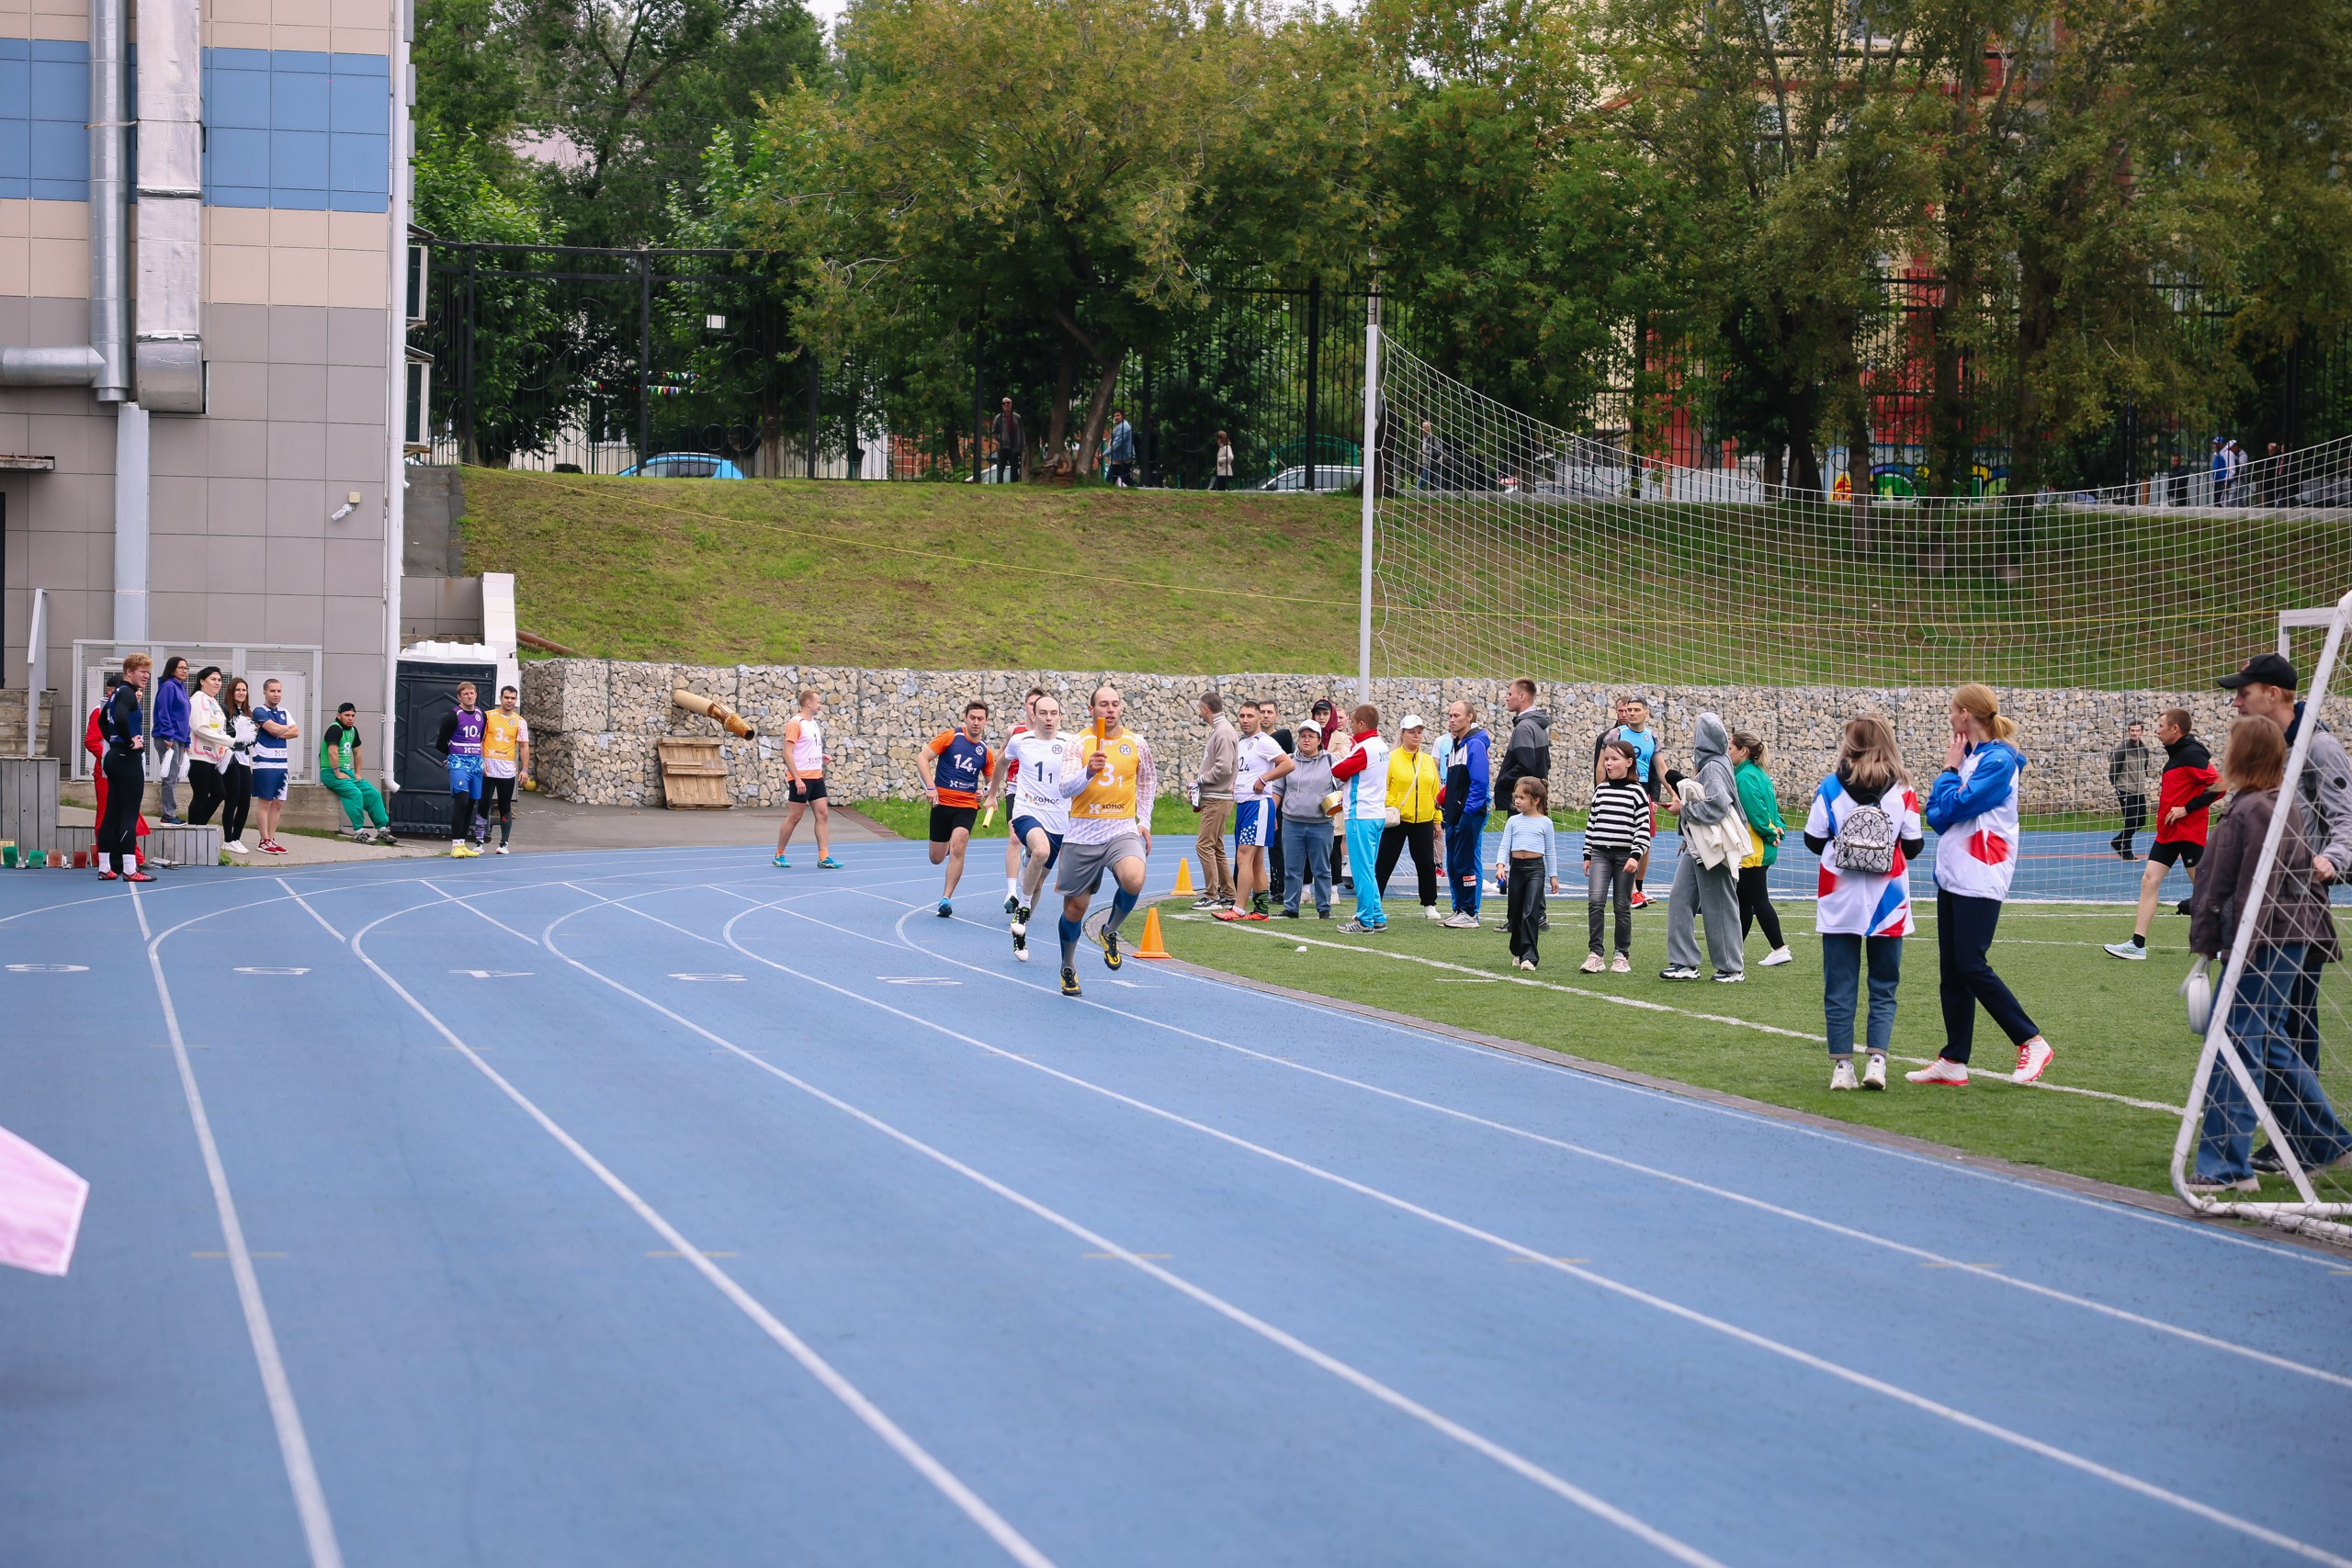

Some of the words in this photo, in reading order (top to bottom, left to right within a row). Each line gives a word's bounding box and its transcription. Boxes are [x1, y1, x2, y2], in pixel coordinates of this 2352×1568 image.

[463, 726, 478, 738] 10
[494, 728, 503, 740] 3
[954, 754, 973, 773] 14
[1238, 757, 1244, 772] 2
[1035, 761, 1043, 782] 1
[1048, 773, 1053, 784] 1
[1098, 763, 1114, 786] 3
[1118, 775, 1123, 788] 1
[1034, 795, 1059, 805] КОМОС
